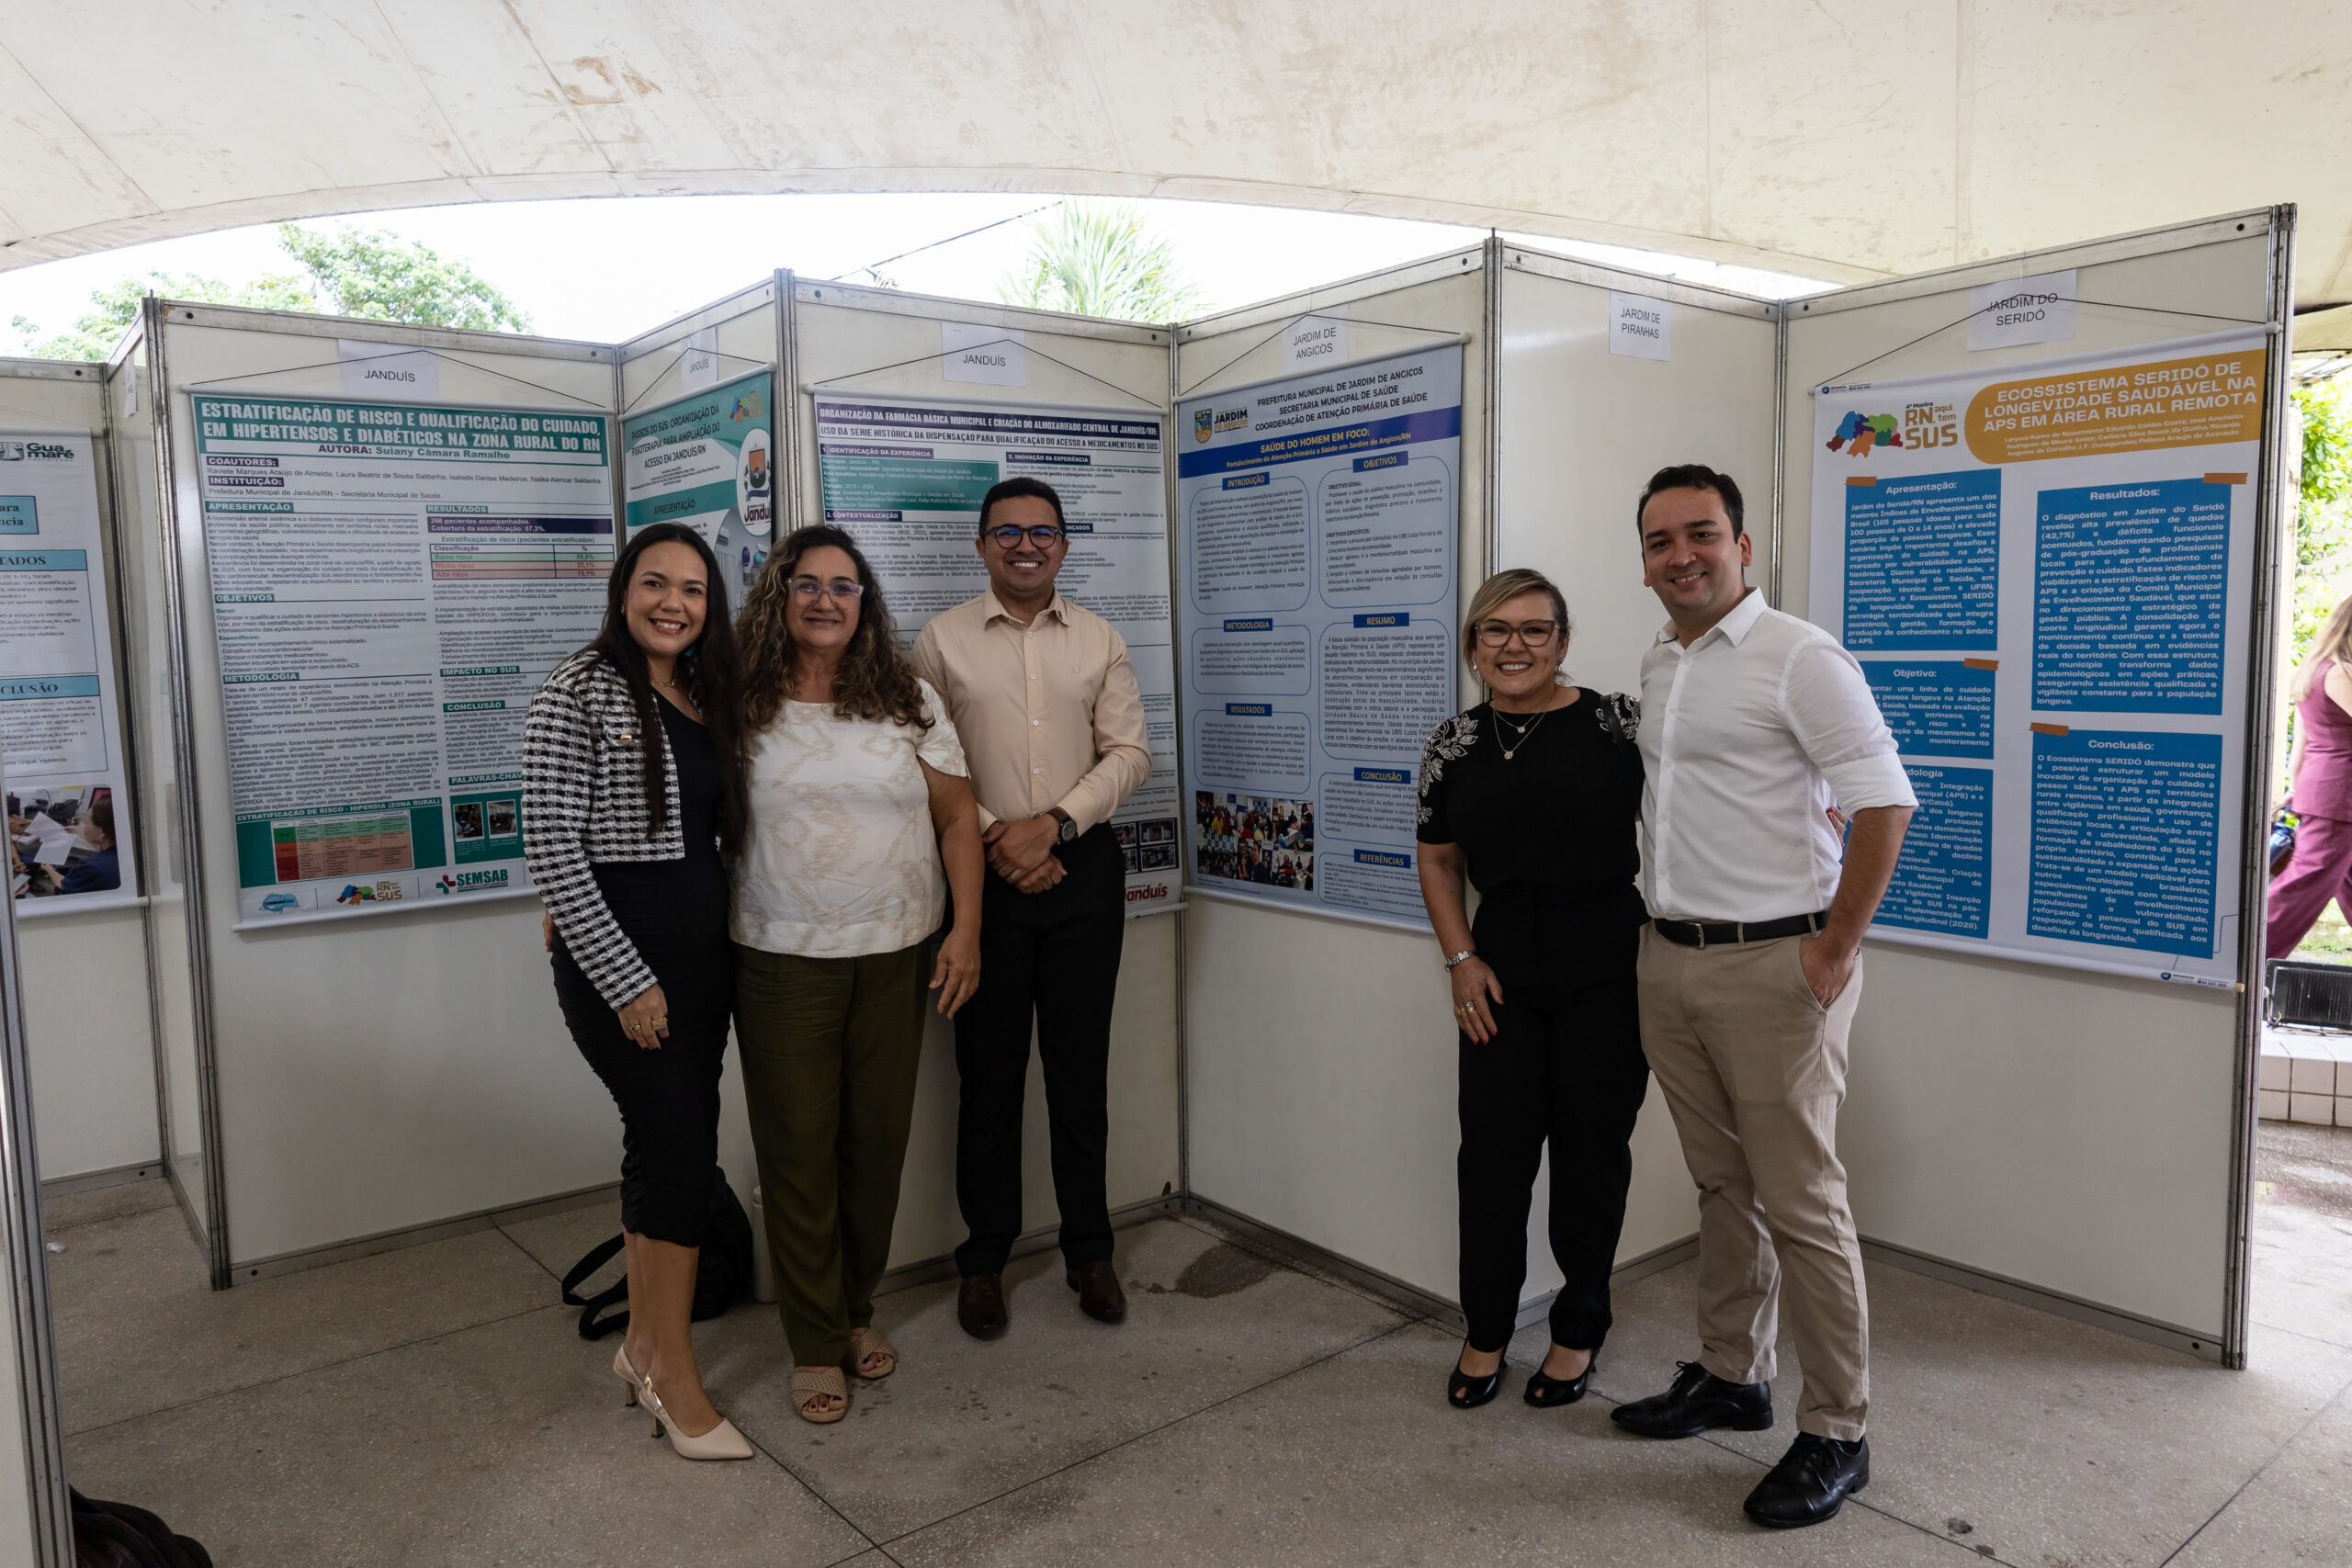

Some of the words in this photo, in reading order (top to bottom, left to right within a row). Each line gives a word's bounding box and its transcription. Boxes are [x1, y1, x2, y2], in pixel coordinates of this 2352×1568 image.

[1986, 296, 2034, 312] JARDIM
[2038, 292, 2058, 305] DO
[1620, 308, 1650, 321] JARDIM
[1651, 312, 1660, 323] DE
[1996, 308, 2045, 326] SERIDÓ
[1293, 330, 1321, 346] JARDIM
[1323, 327, 1337, 338] DE
[1621, 323, 1659, 339] PIRANHAS
[1295, 343, 1333, 360] ANGICOS
[690, 356, 709, 373] JANDUÍS
[963, 354, 1006, 367] JANDUÍS
[364, 369, 416, 382] JANDUÍS
[1997, 376, 2129, 403] ECOSSISTEMA
[2133, 363, 2210, 386] SERIDÓ
[2214, 361, 2242, 377] DE
[1257, 392, 1296, 407] PREFEITURA
[1298, 386, 1335, 398] MUNICIPAL
[1336, 382, 1347, 391] DE
[1349, 376, 1376, 389] JARDIM
[1377, 374, 1388, 383] DE
[1389, 366, 1423, 381] ANGICOS
[1279, 400, 1319, 415] SECRETARIA
[1320, 392, 1360, 407] MUNICIPAL
[1361, 390, 1371, 400] DE
[1373, 385, 1399, 398] SAÚDE
[1984, 391, 2113, 418] LONGEVIDADE
[2118, 380, 2222, 403] SAUDÁVEL
[2226, 376, 2257, 390] NA
[1255, 414, 1305, 432] COORDENAÇÃO
[1306, 413, 1315, 423] DE
[1317, 406, 1351, 421] ATENÇÃO
[1352, 400, 1389, 414] PRIMÁRIA
[1390, 398, 1400, 407] DE
[1401, 392, 1428, 405] SAÚDE
[1934, 403, 1953, 413] aqui
[1984, 418, 2017, 433] APS
[2021, 414, 2047, 428] EM
[2052, 408, 2100, 425] ÁREA
[2105, 401, 2166, 419] RURAL
[2171, 391, 2257, 412] REMOTA
[201, 402, 333, 423] ESTRATIFICAÇÃO
[336, 409, 356, 423] DE
[359, 410, 402, 426] RISCO
[408, 413, 416, 426] E
[419, 413, 517, 433] QUALIFICAÇÃO
[522, 418, 538, 431] DO
[543, 419, 601, 436] CUIDADO,
[631, 425, 649, 440] PASSOS
[650, 424, 657, 434] DO
[658, 422, 669, 431] SUS:
[671, 407, 709, 428] ORGANIZAÇÃO
[711, 405, 719, 414] DA
[820, 408, 872, 421] ORGANIZAÇÃO
[886, 412, 922, 423] FARMÁCIA
[923, 414, 949, 424] BÁSICA
[950, 416, 987, 426] MUNICIPAL
[988, 418, 992, 426] E
[994, 417, 1022, 429] CRIAÇÃO
[1023, 420, 1032, 429] DO
[1035, 421, 1081, 432] ALMOXARIFADO
[1082, 423, 1110, 434] CENTRAL
[1111, 425, 1118, 434] DE
[1214, 410, 1248, 424] JARDIM
[1938, 413, 1957, 422] tem
[203, 422, 227, 437] EM
[233, 423, 338, 441] HIPERTENSOS
[344, 428, 353, 442] E
[357, 427, 443, 446] DIABÉTICOS
[447, 432, 468, 446] NA
[472, 434, 509, 448] ZONA
[514, 435, 557, 450] RURAL
[561, 437, 579, 451] DO
[582, 438, 601, 451] RN
[632, 440, 662, 456] FISIOTERAPIA
[663, 434, 677, 446] PARA
[679, 423, 712, 443] AMPLIAÇÃO
[712, 423, 720, 431] DO
[821, 426, 836, 434] USO
[838, 427, 848, 435] DA
[850, 426, 872, 436] SÉRIE
[874, 428, 912, 438] HISTÓRICA
[914, 431, 923, 439] DA
[976, 434, 994, 443] PARA
[1057, 438, 1080, 446] ACESSO
[1088, 440, 1136, 449] MEDICAMENTOS
[1261, 440, 1285, 454] SAÚDE
[1287, 439, 1298, 449] DO
[1300, 434, 1329, 447] HOMEM
[1331, 432, 1344, 442] EM
[1346, 428, 1370, 439] FOCO:
[1905, 423, 1959, 451] SUS
[27, 443, 64, 452] Gua
[28, 449, 74, 459] maré
[318, 445, 372, 455] AUTORA:
[417, 447, 459, 457] Câmara
[463, 449, 510, 459] Ramalho
[209, 457, 277, 467] COAUTORES:
[644, 456, 663, 468] ACESSO
[663, 454, 673, 464] EM
[673, 444, 707, 461] JANDUÍS/RN
[1363, 456, 1396, 468] OBJETIVOS
[210, 477, 283, 486] INSTITUIÇÃO:
[1227, 474, 1265, 488] INTRODUÇÃO
[1885, 480, 1957, 496] Apresentação:
[2090, 489, 2160, 501] Resultados:
[209, 502, 290, 512] APRESENTAÇÃO
[654, 498, 695, 516] APRESENTAÇÃO
[2055, 511, 2108, 522] diagnóstico
[2134, 507, 2166, 515] Jardim
[2192, 503, 2225, 512] Seridó
[1226, 620, 1270, 630] METODOLOGIA
[1366, 615, 1396, 626] RESUMO
[224, 673, 297, 682] METODOLOGIA
[1893, 669, 1937, 679] Objetivo:
[1, 682, 59, 694] CLUSÃO
[447, 702, 502, 711] CONCLUSÃO
[1230, 705, 1265, 714] RESULTADOS
[2088, 739, 2154, 750] Conclusão:
[1361, 771, 1403, 782] CONCLUSÃO
[1905, 768, 1943, 778] dologia
[237, 810, 305, 821] ESTRATIFICAÇÃO
[350, 803, 386, 811] HIPERDIA
[389, 800, 412, 809] (ZONA
[413, 798, 441, 807] RURAL)
[1360, 852, 1405, 866] REFERÊNCIAS
[457, 870, 508, 885] SEMSAB
